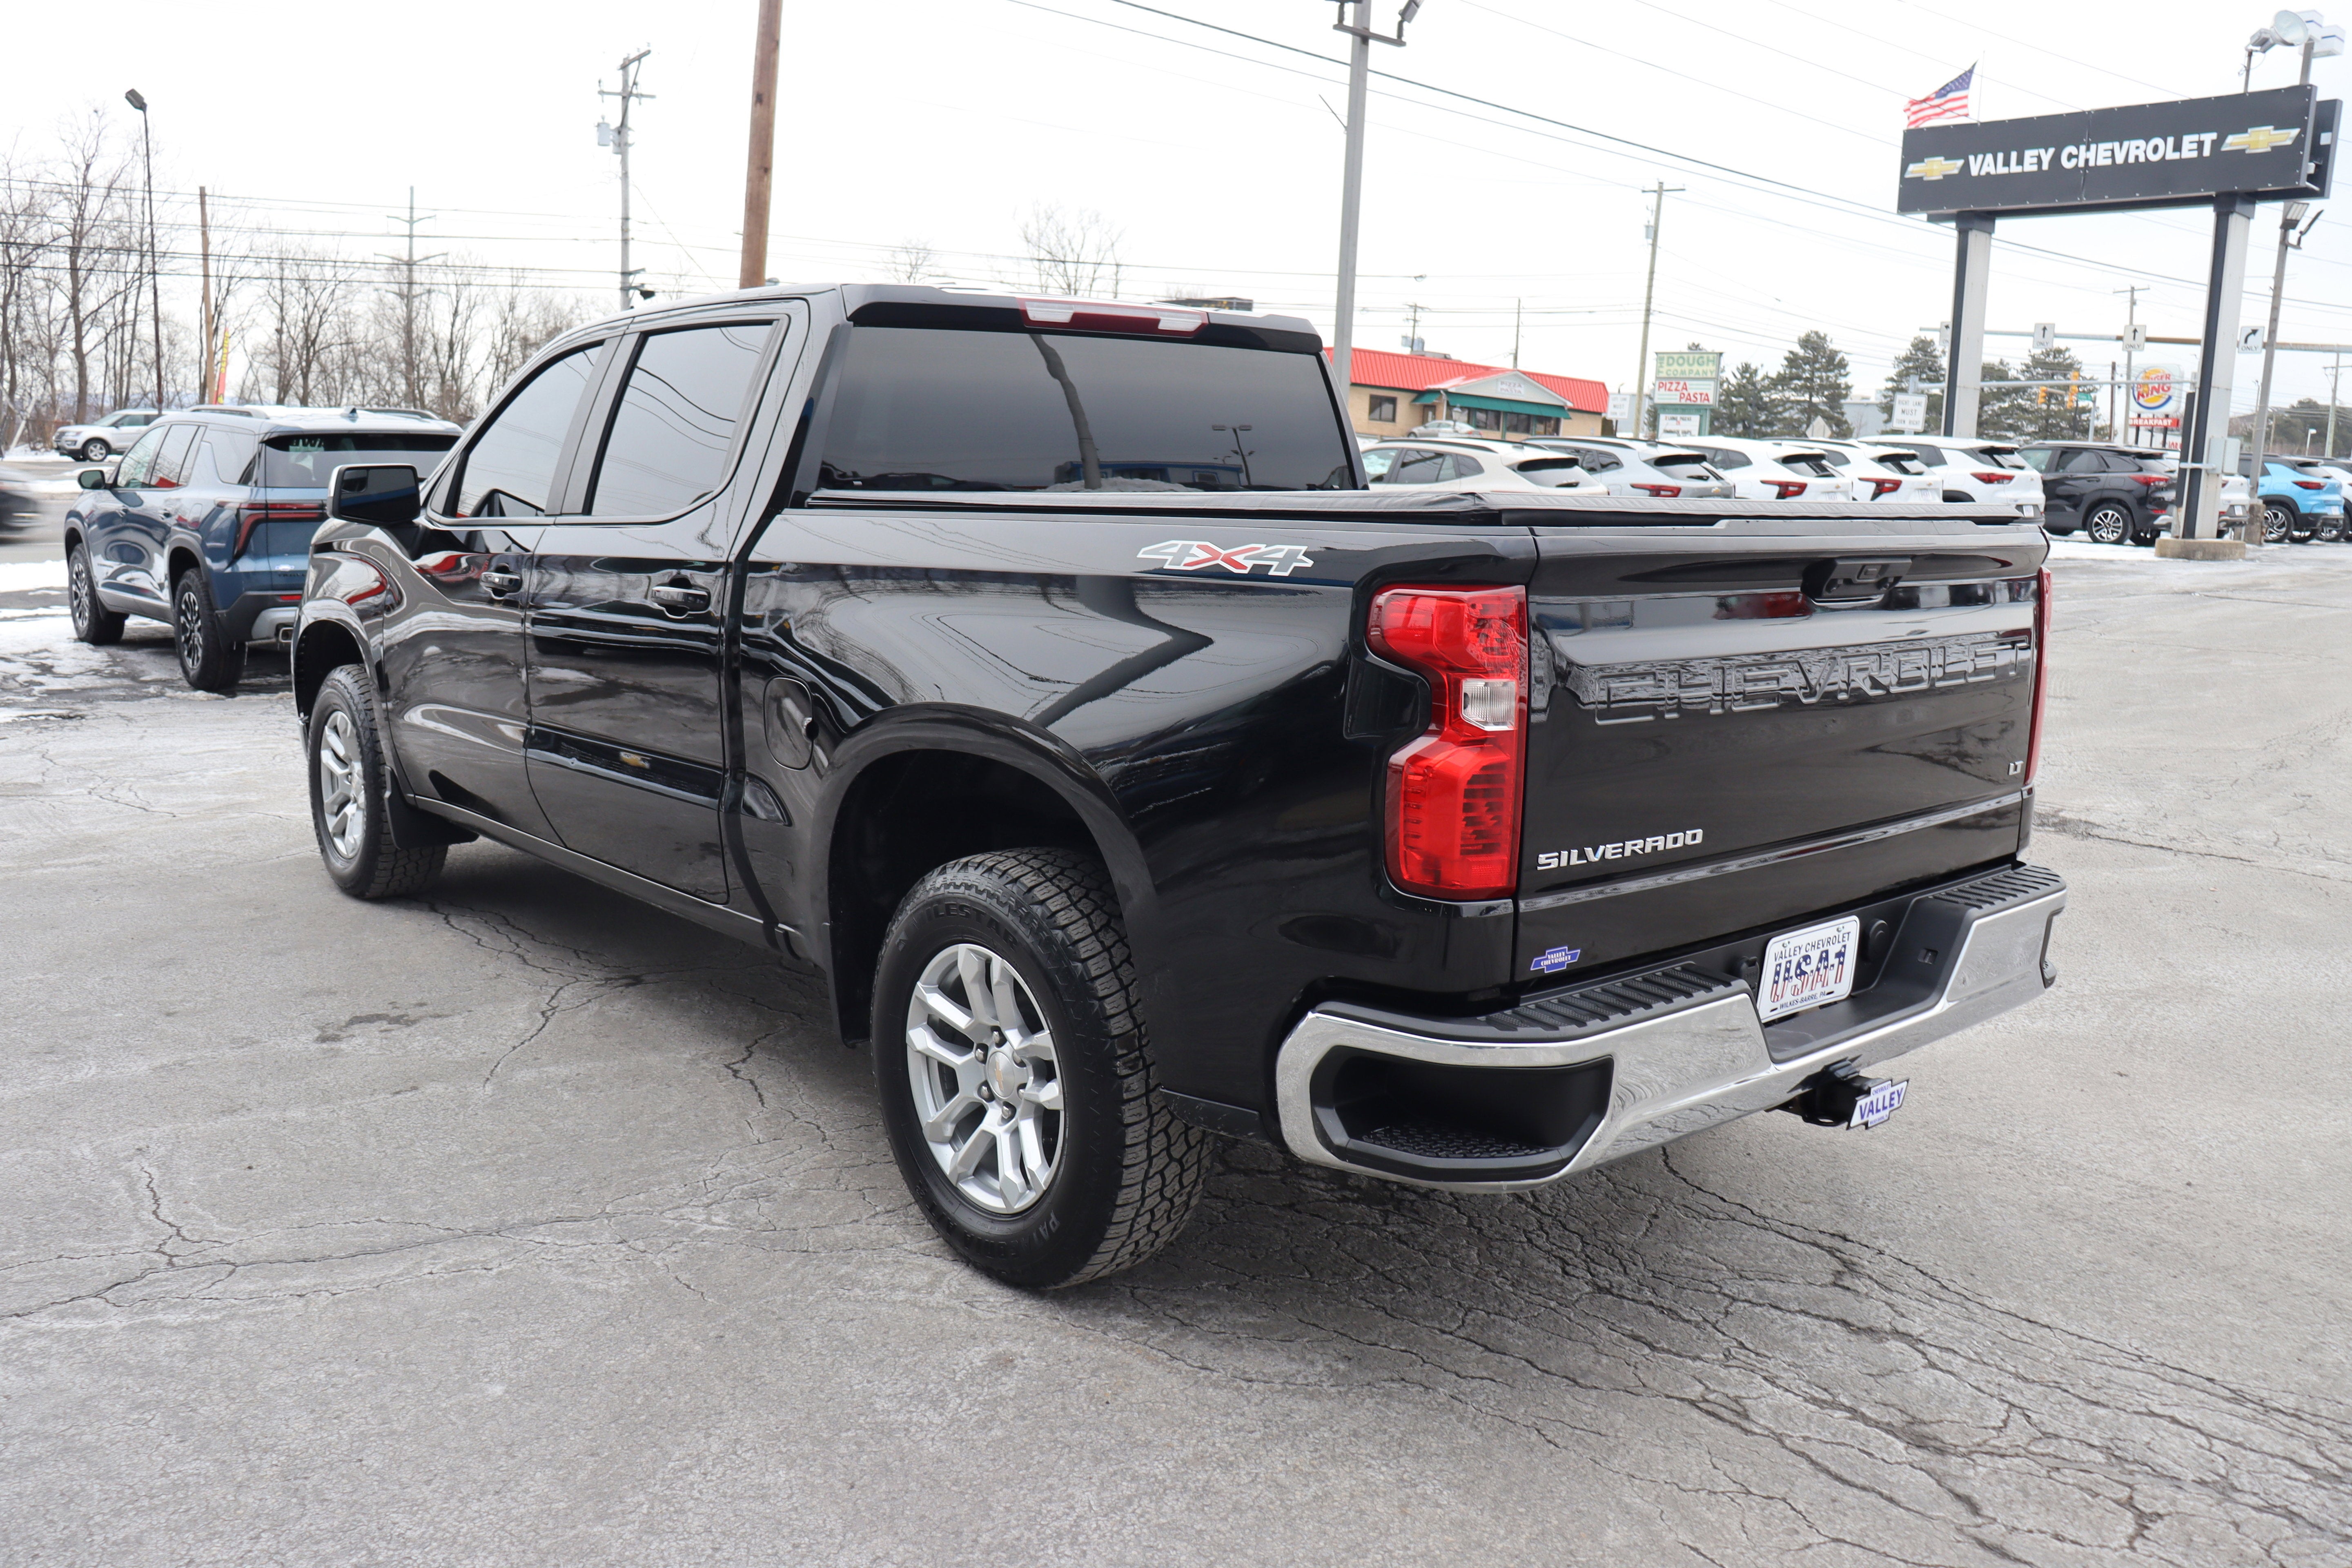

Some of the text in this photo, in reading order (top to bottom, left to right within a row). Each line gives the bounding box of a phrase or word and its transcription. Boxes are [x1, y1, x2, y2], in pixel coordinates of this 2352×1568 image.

[1969, 132, 2217, 176] VALLEY CHEVROLET
[1666, 356, 1715, 367] DOUGH
[1658, 381, 1688, 392] PIZZA
[1679, 392, 1710, 403] PASTA
[1595, 636, 2029, 726] CHEVROLET
[2009, 760, 2024, 776] LT
[1537, 829, 1703, 871] SILVERADO
[1774, 931, 1851, 962] VALLEY CHEVROLET
[1541, 955, 1571, 966] CHEVROLET
[1548, 951, 1565, 960] VALLEY
[1872, 1083, 1891, 1096] CHEVROLET
[1859, 1087, 1904, 1120] VALLEY
